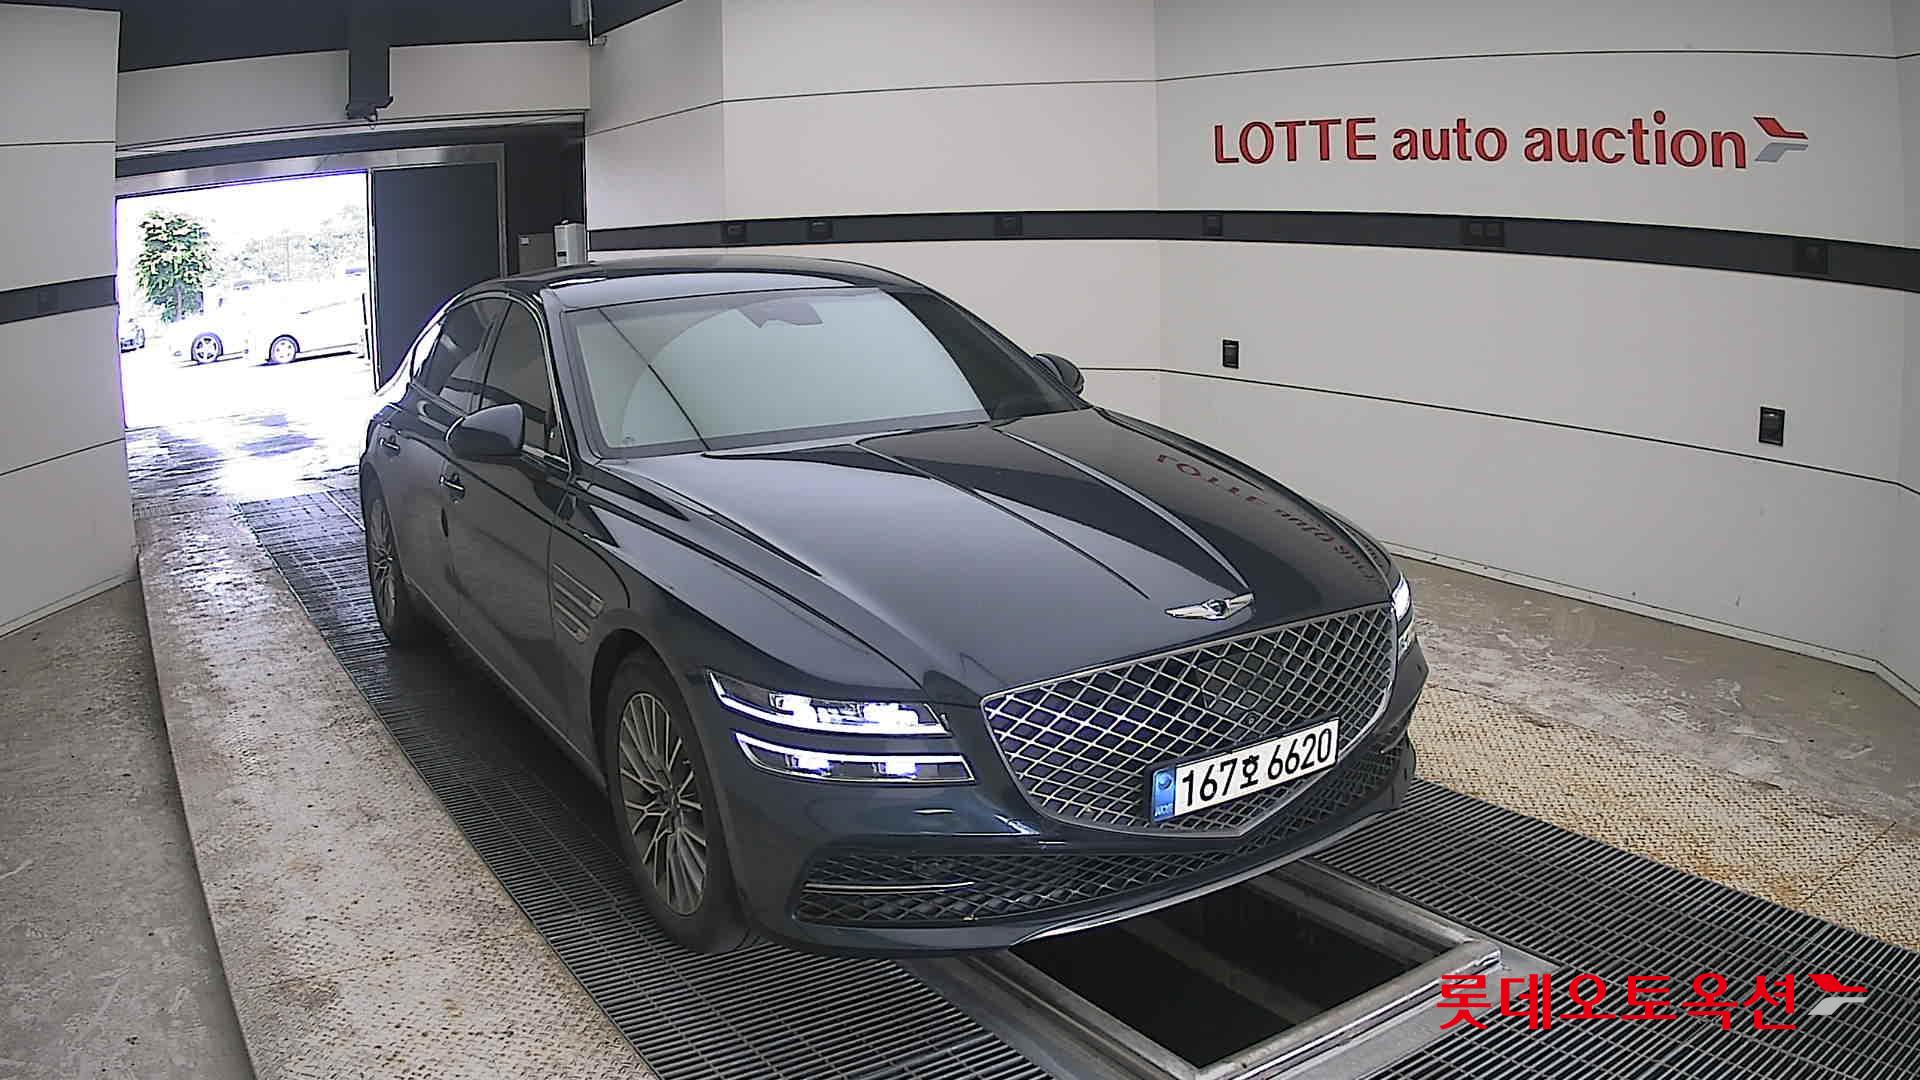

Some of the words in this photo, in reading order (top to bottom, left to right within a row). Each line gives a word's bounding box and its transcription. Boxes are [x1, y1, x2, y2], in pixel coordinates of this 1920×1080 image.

[1213, 116, 1376, 165] LOTTE
[1392, 117, 1509, 162] auto
[1523, 111, 1747, 169] auction
[1181, 754, 1260, 807] 167호
[1267, 727, 1332, 780] 6620
